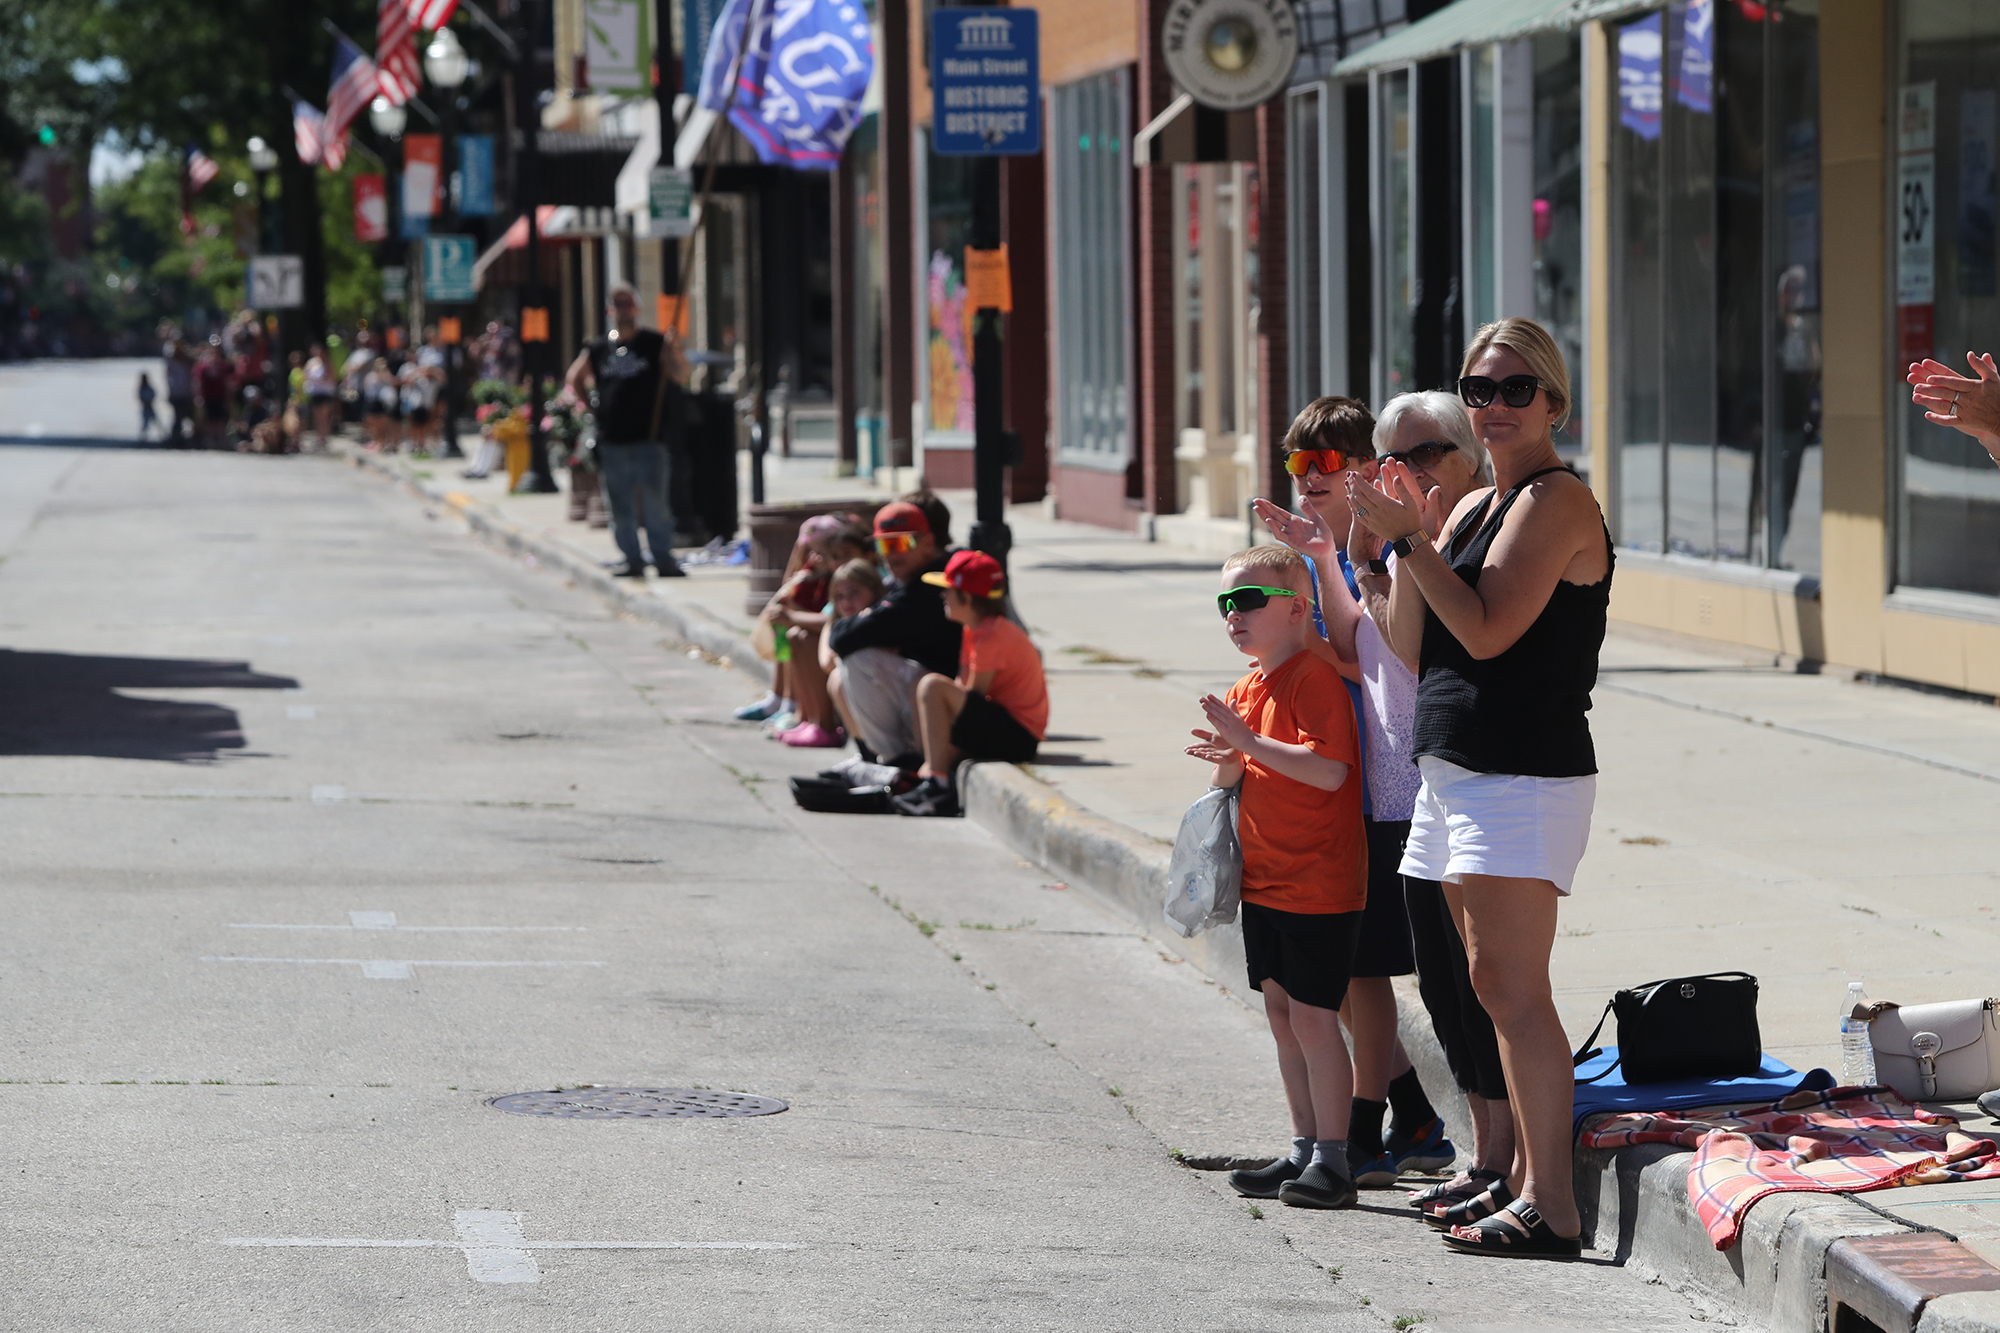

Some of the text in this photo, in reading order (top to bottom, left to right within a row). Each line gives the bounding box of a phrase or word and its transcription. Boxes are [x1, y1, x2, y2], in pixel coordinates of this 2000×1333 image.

[943, 59, 1028, 76] Main Street
[944, 86, 1028, 107] HISTORIC
[945, 112, 1027, 134] DISTRICT
